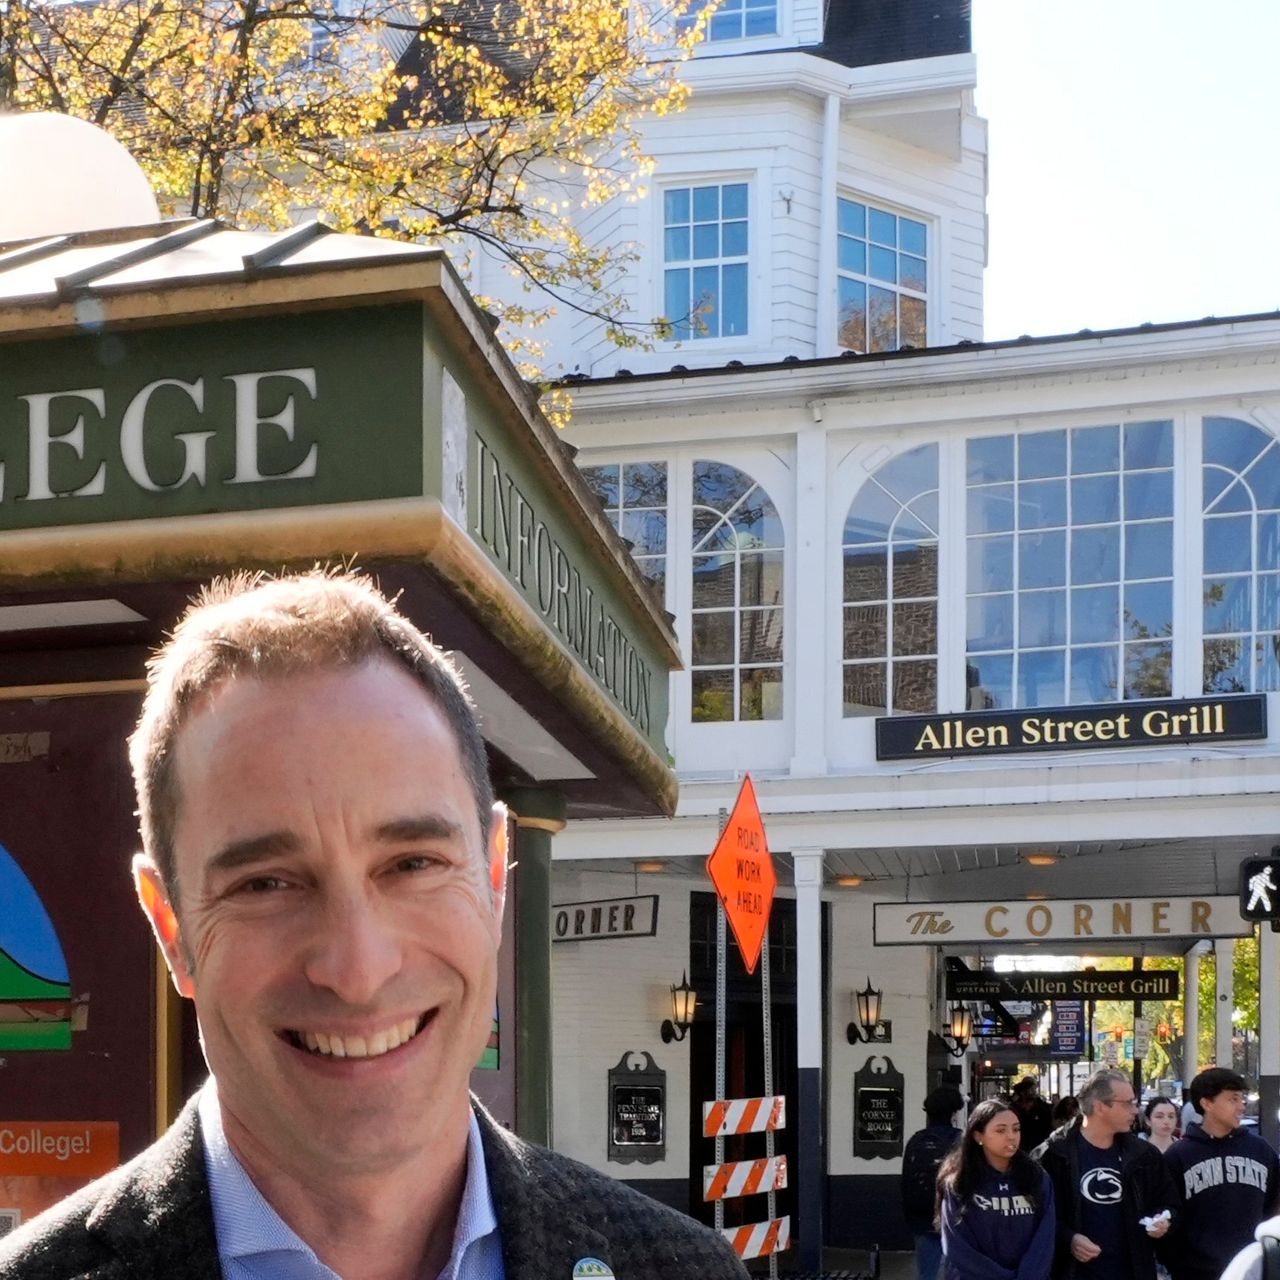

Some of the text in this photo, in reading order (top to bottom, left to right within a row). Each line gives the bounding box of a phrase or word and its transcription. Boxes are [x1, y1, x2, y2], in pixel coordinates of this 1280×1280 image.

[474, 430, 651, 736] INFORMATION
[915, 704, 1224, 751] Allen Street Grill
[737, 826, 759, 853] ROAD
[736, 858, 761, 884] WORK
[737, 890, 762, 915] AHEAD
[555, 904, 636, 937] ORNER
[906, 900, 1213, 937] The CORNER
[1021, 978, 1170, 994] Allen Street Grill
[871, 1099, 888, 1108] THE
[867, 1122, 892, 1131] ROOM
[1183, 1157, 1224, 1200] PENN
